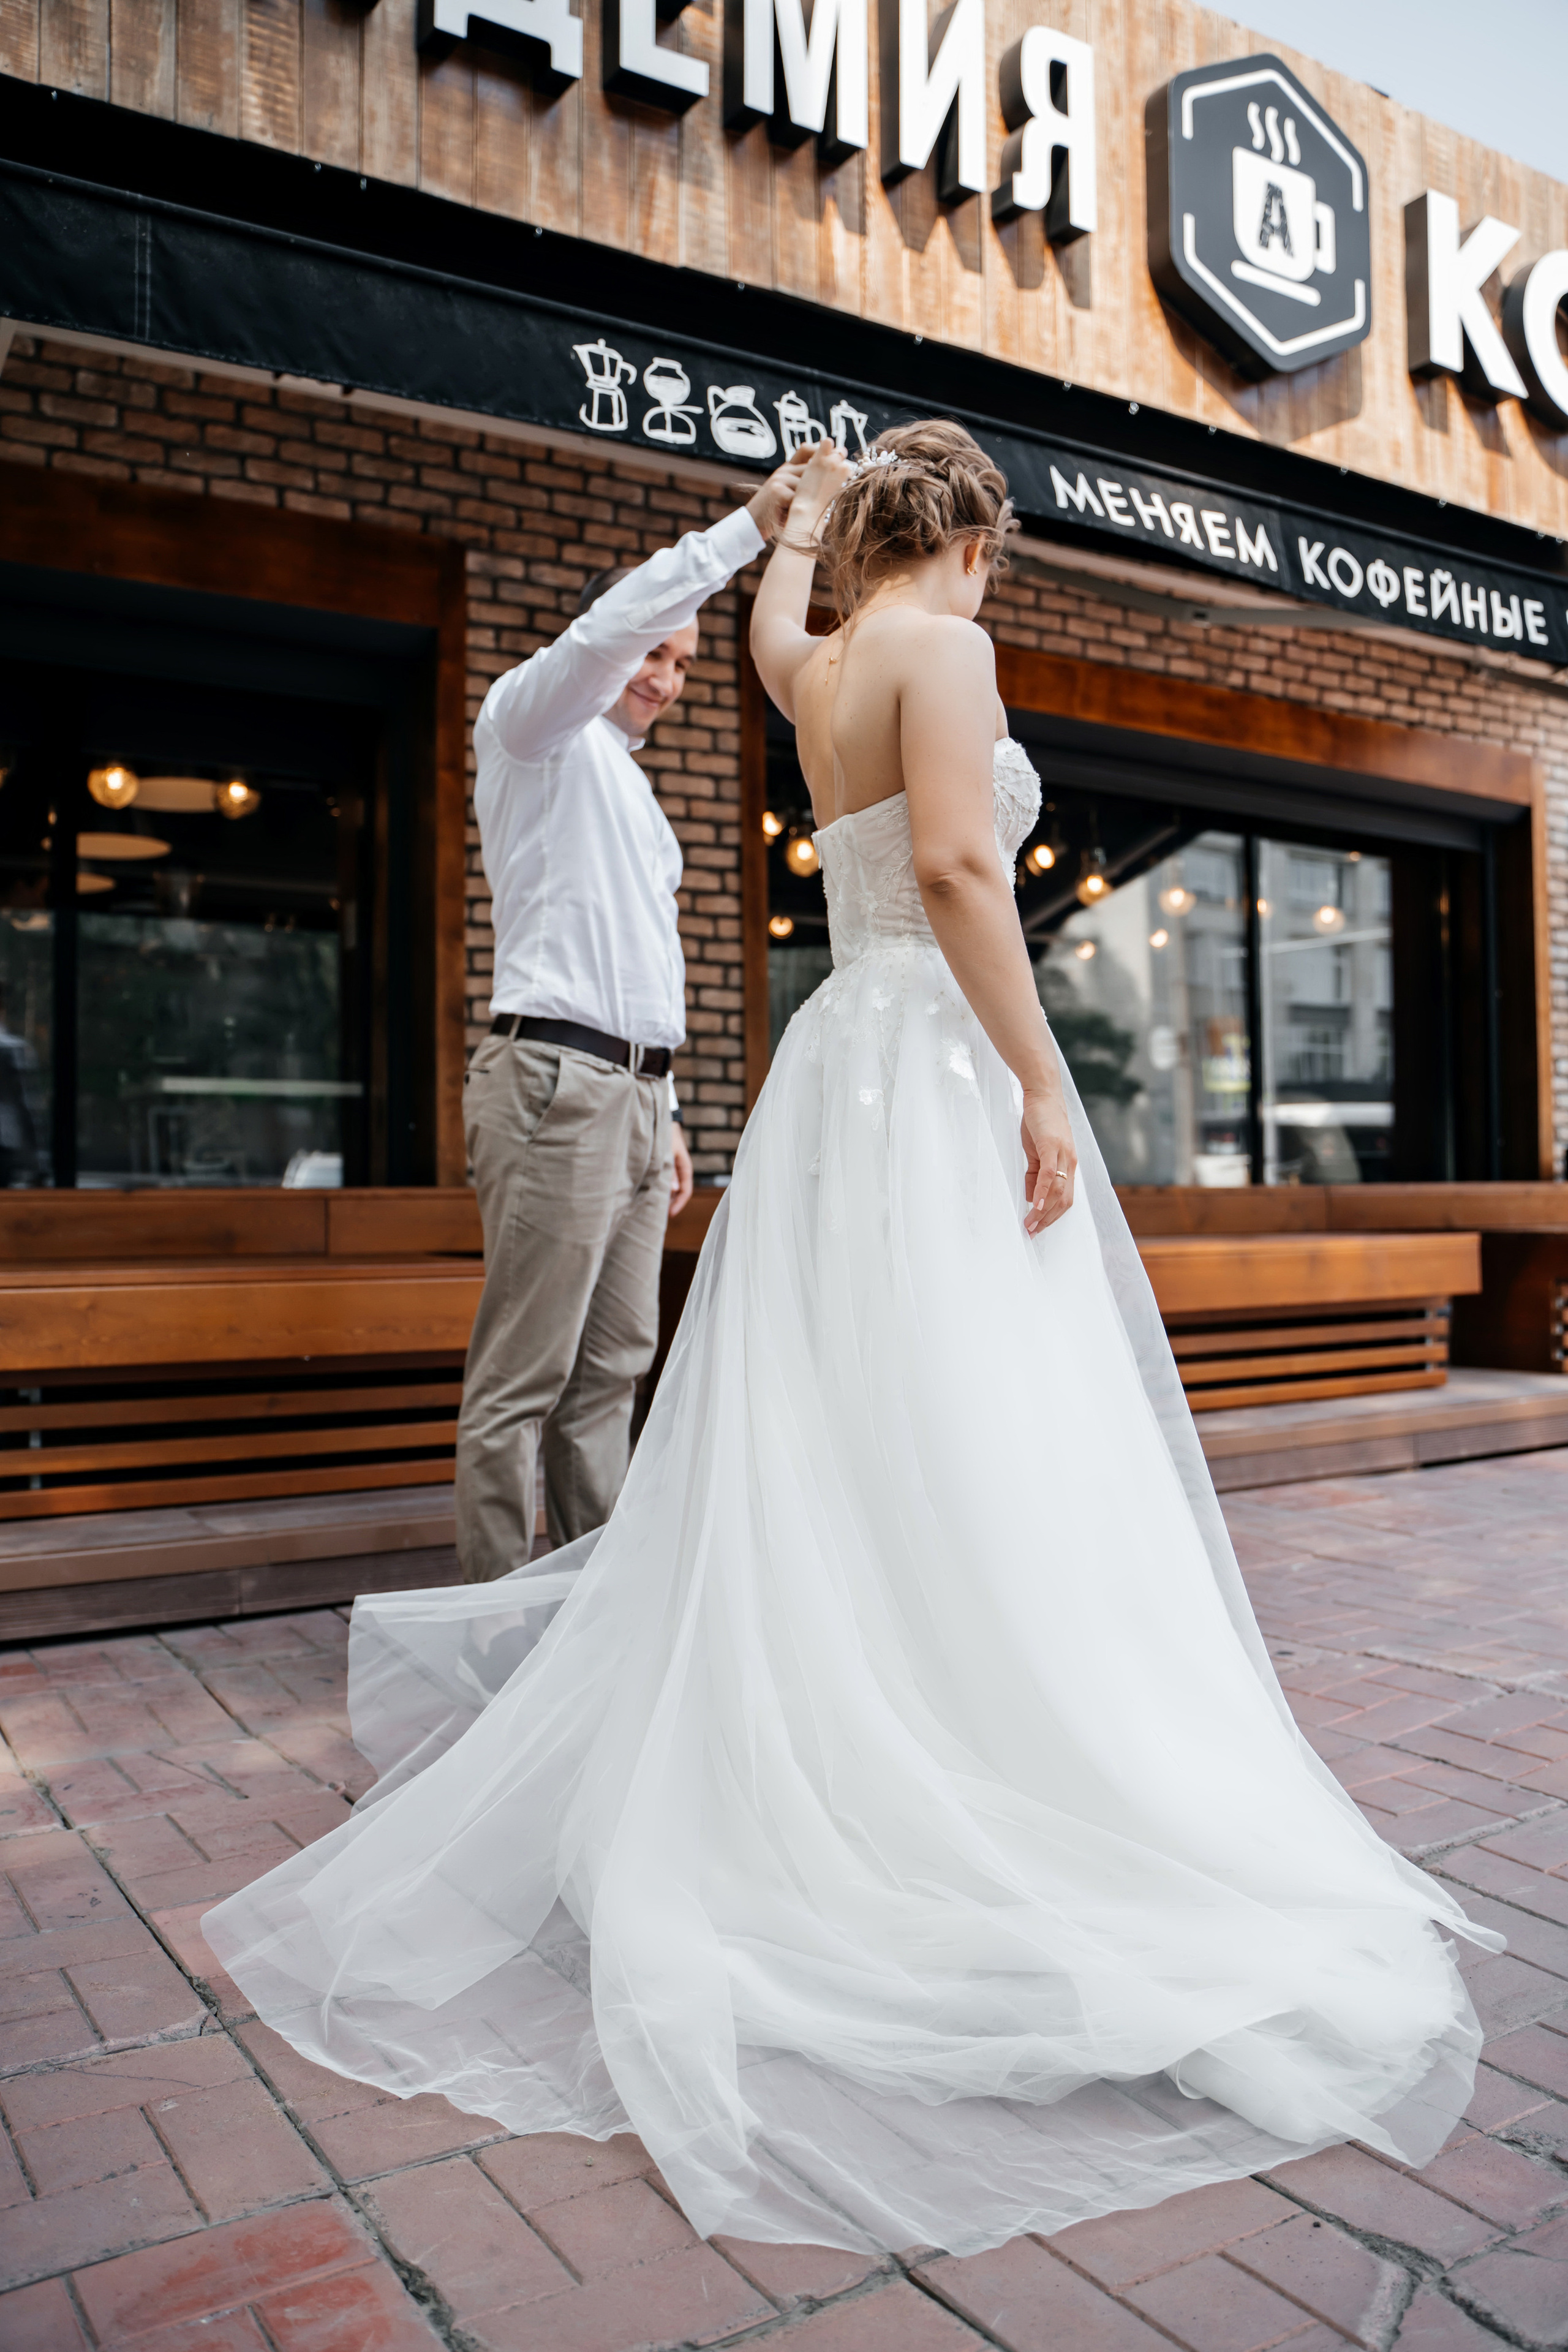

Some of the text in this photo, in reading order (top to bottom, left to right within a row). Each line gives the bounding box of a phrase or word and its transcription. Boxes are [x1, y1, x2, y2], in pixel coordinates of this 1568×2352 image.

[434, 0, 1098, 234] МИЯ
[1049, 465, 1549, 646] МЕНЯЕМ КОФЕЙНЫЕ
